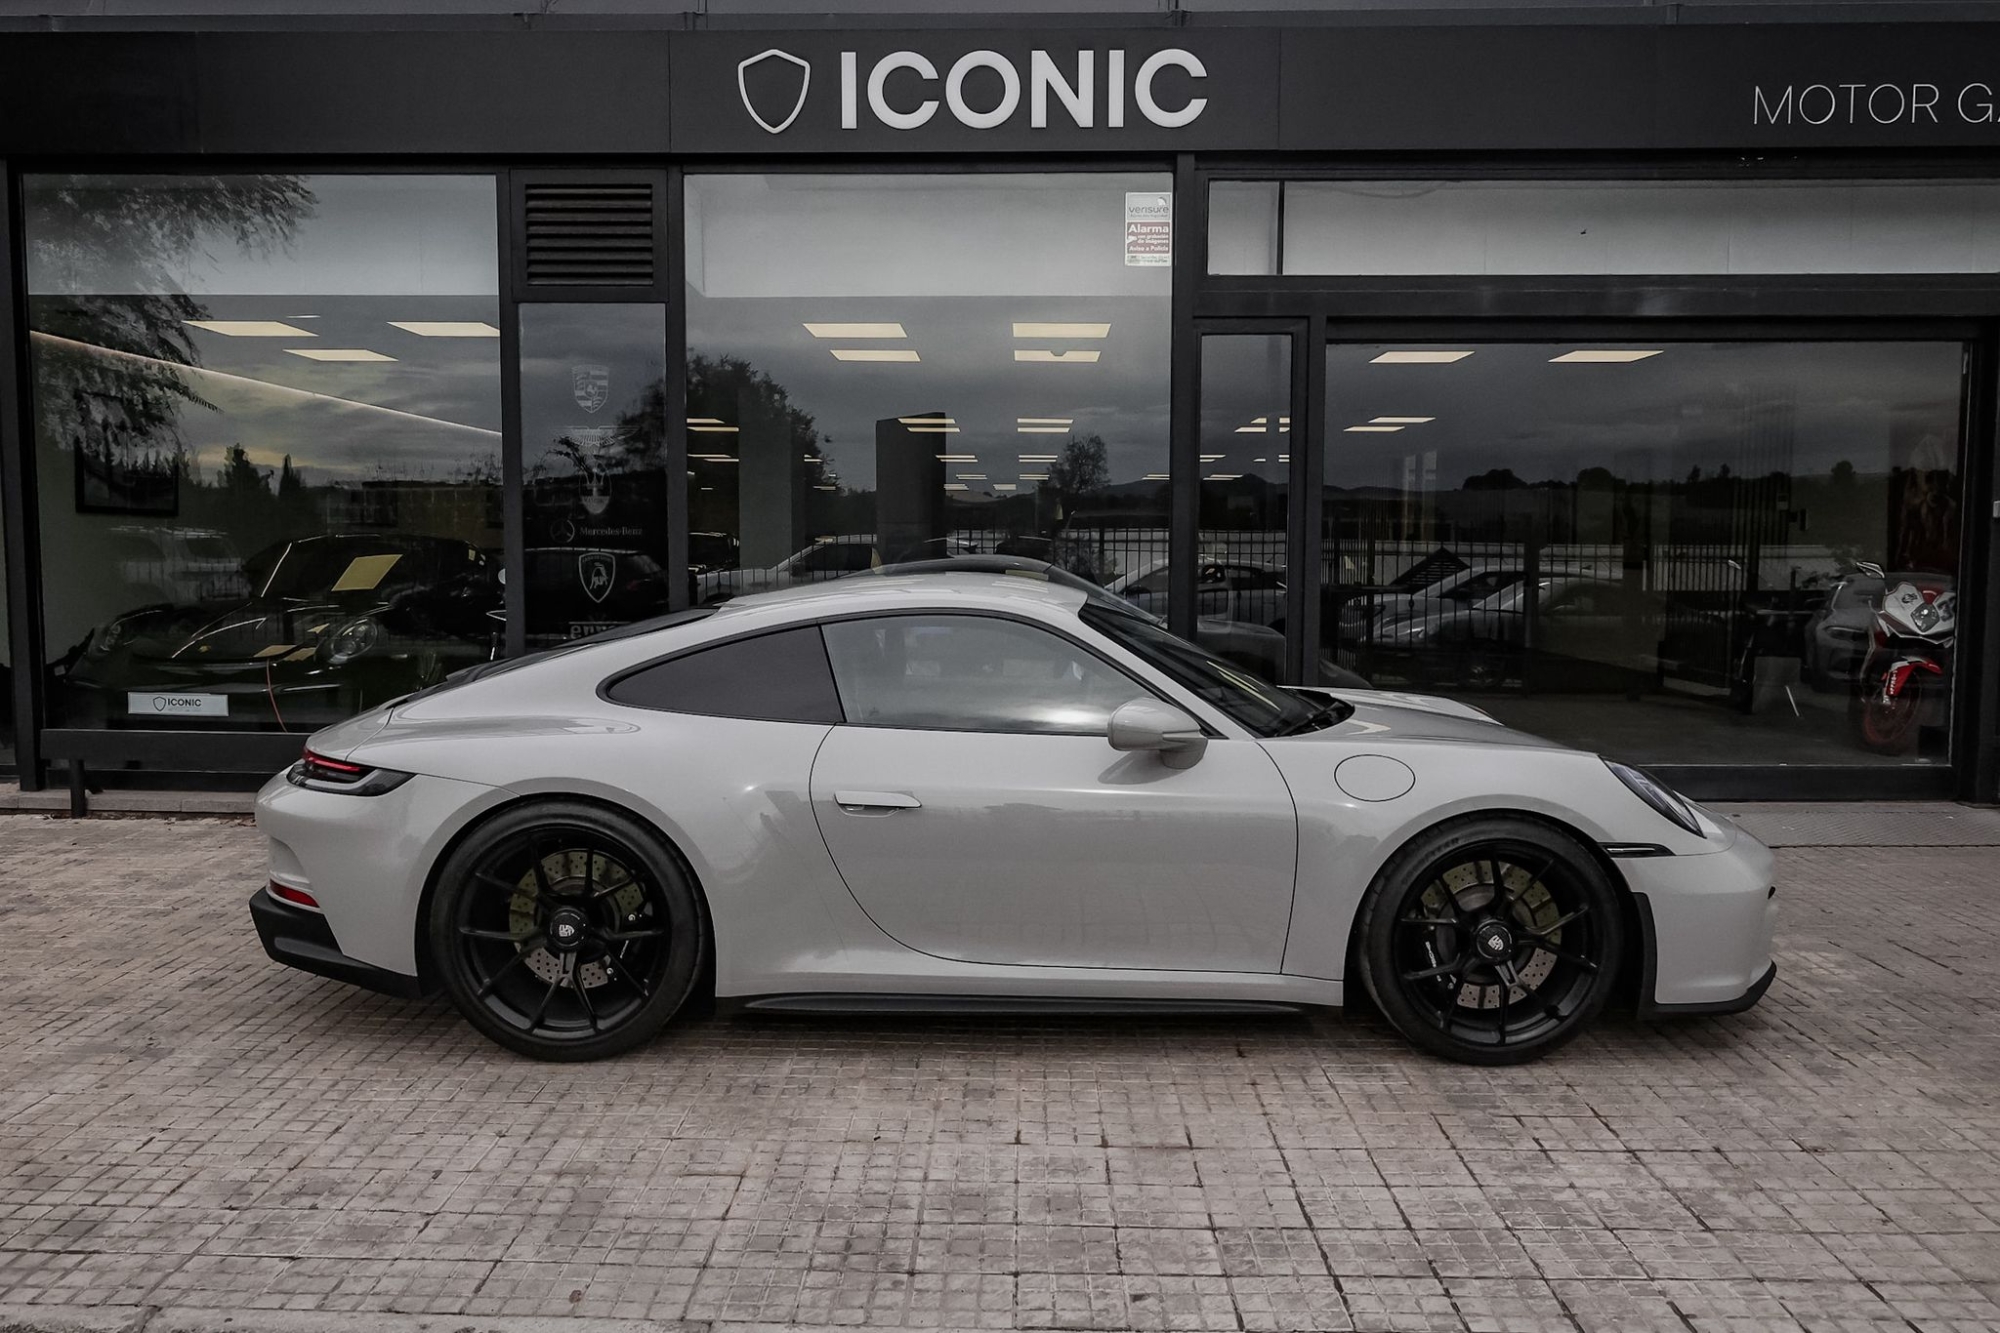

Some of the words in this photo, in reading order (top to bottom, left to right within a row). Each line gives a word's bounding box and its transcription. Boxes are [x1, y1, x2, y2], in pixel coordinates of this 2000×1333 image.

[841, 48, 1208, 129] ICONIC
[1753, 83, 1939, 125] MOTOR
[1957, 82, 2000, 123] G
[1128, 206, 1169, 214] verisure
[1128, 223, 1169, 233] Alarma
[580, 526, 643, 536] Mercedes-Benz
[167, 698, 202, 707] ICONIC
